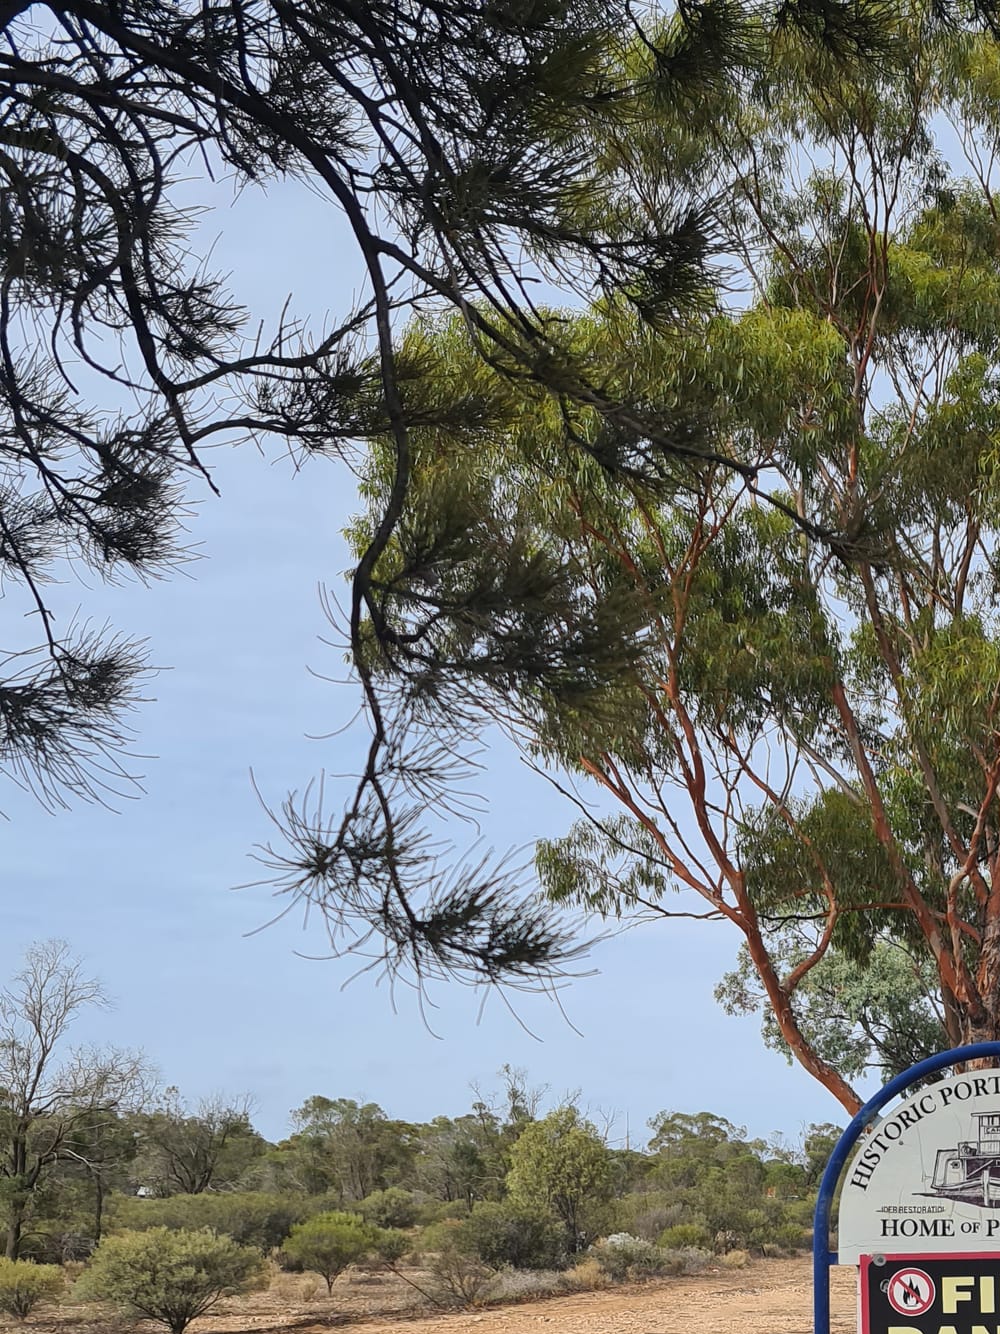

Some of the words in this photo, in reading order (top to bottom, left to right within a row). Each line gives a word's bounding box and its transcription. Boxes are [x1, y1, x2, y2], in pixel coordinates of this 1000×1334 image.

[850, 1095, 937, 1191] HISTORIC
[880, 1218, 955, 1237] HOME
[960, 1222, 981, 1234] OF
